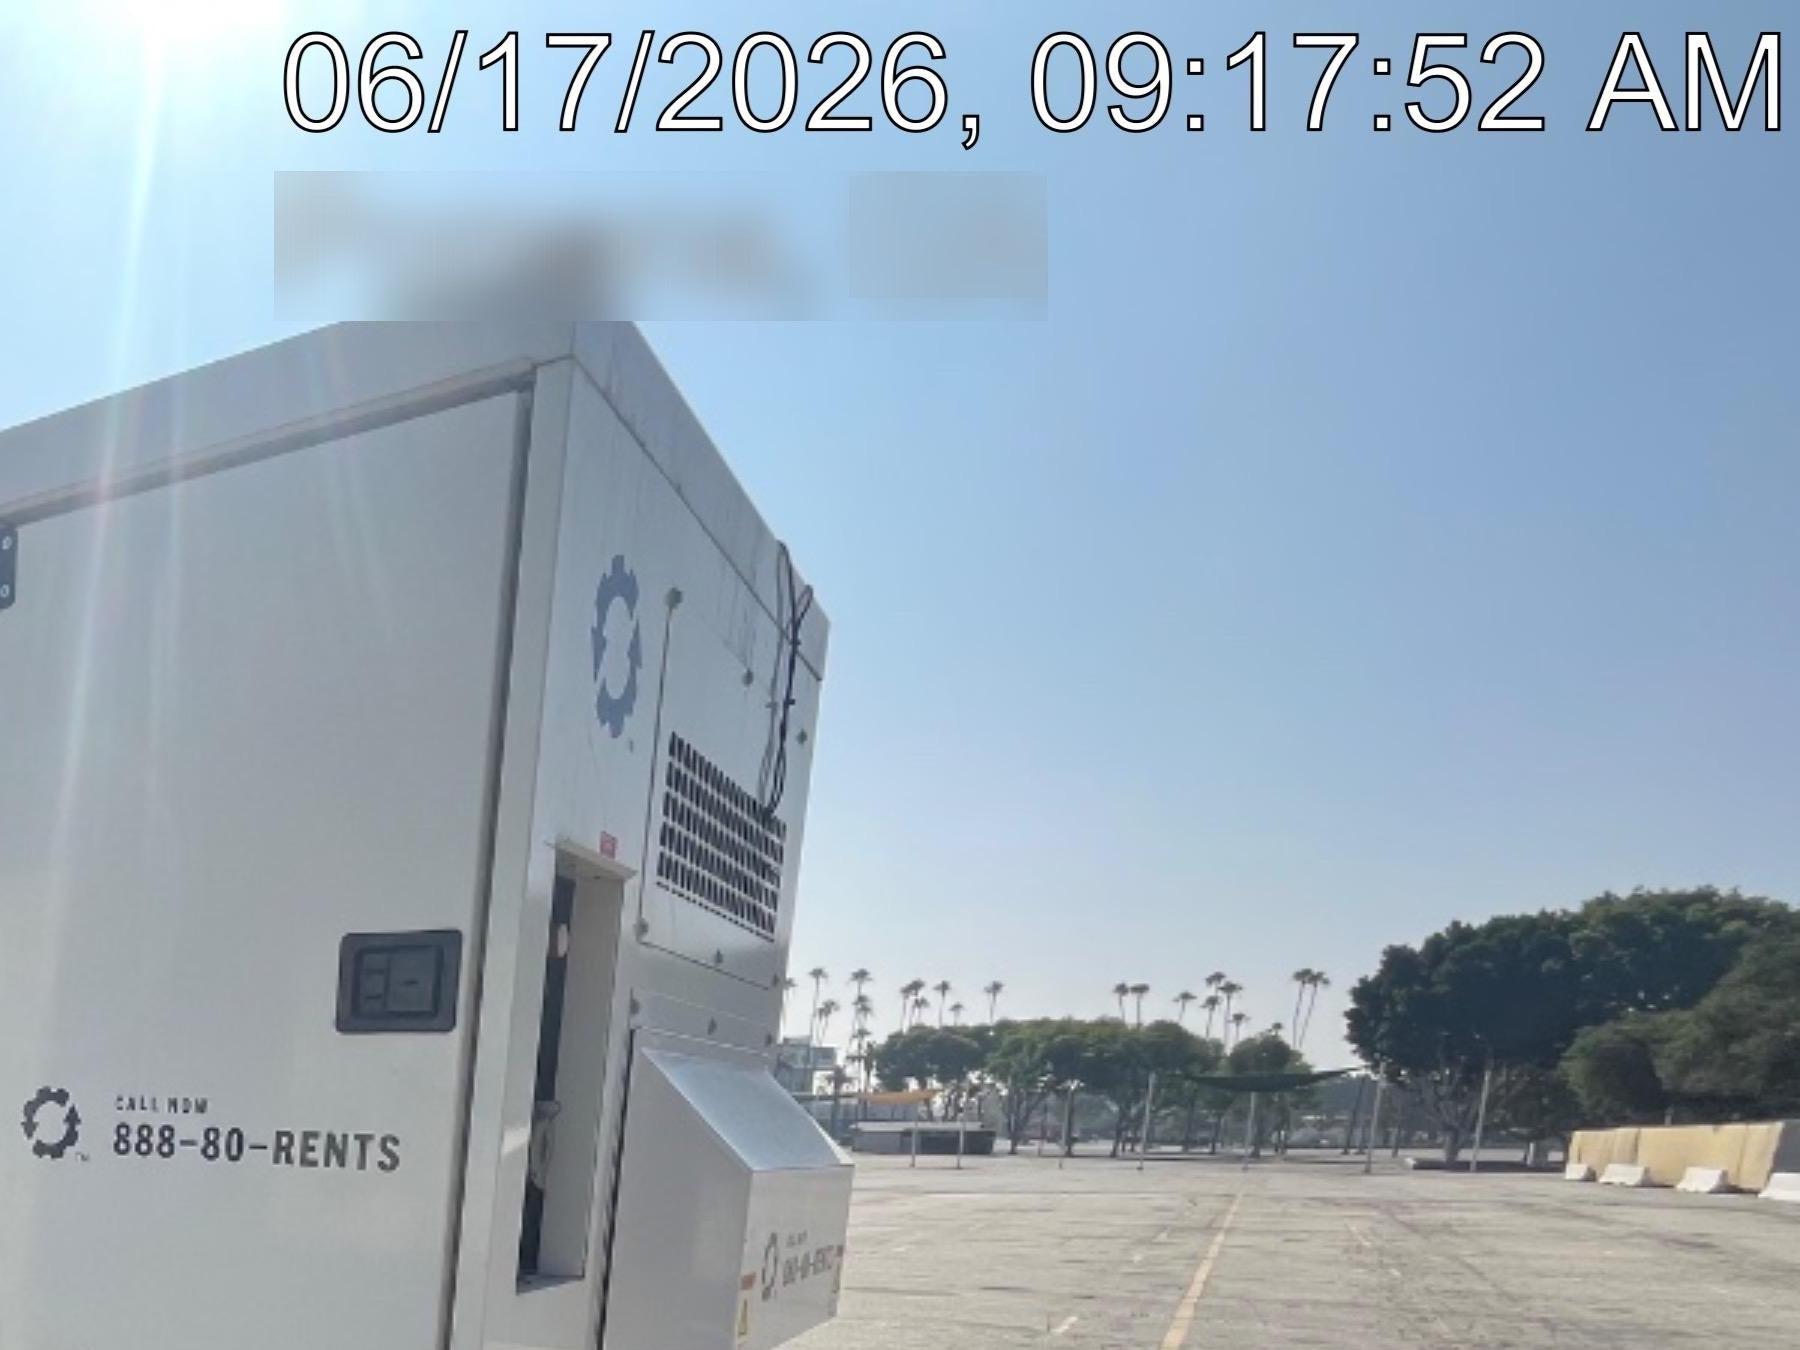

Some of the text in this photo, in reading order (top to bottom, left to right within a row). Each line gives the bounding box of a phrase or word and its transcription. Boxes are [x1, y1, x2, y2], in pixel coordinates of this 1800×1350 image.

[115, 1094, 209, 1114] CALL NOW
[112, 1121, 401, 1173] 888-80-RENTS
